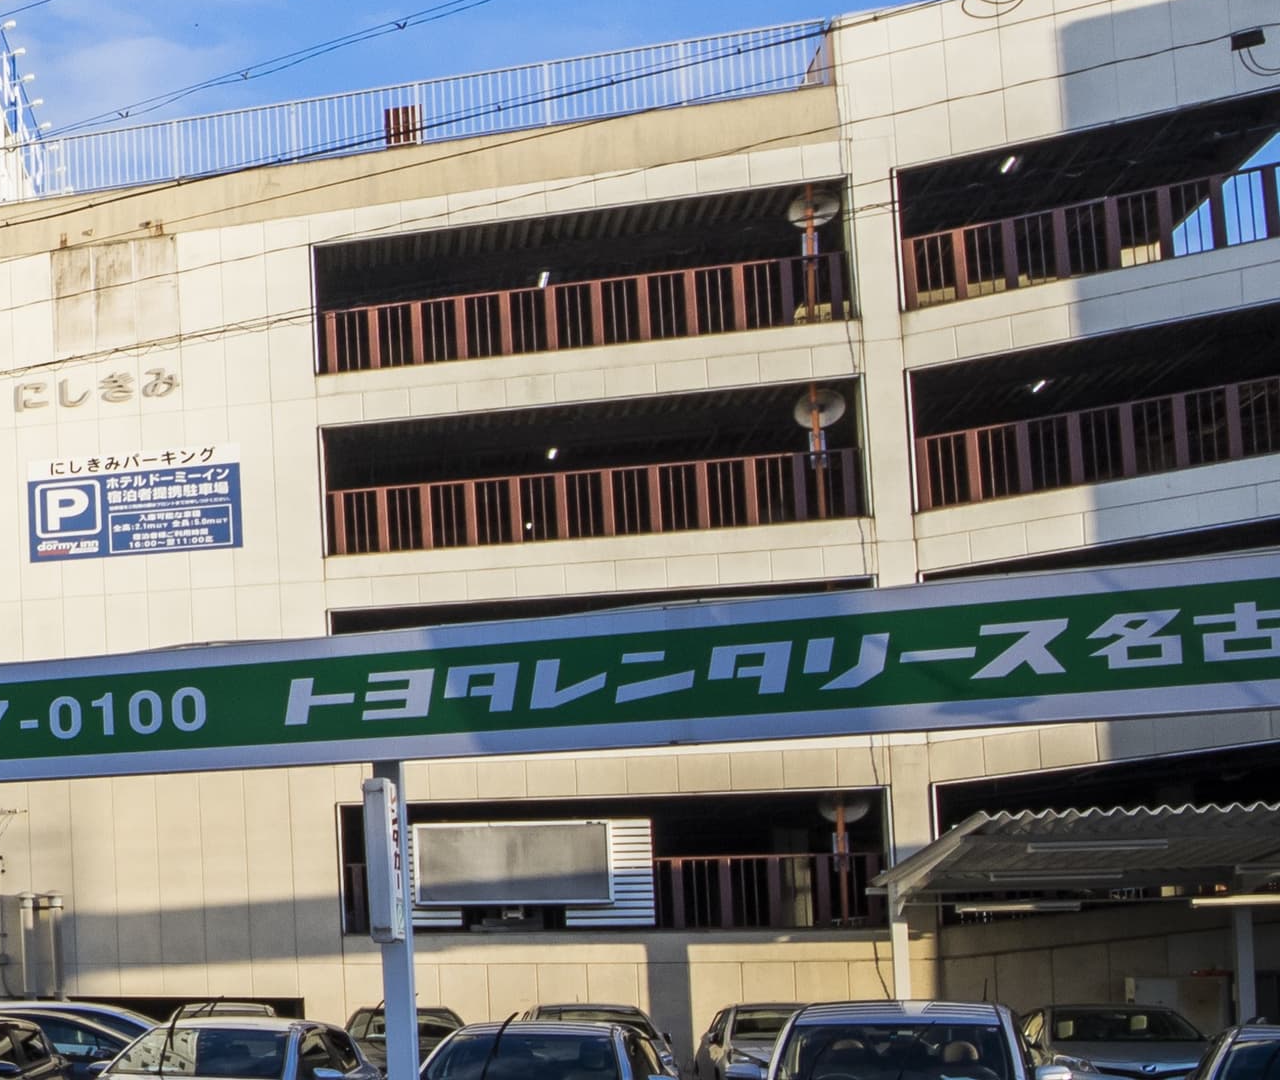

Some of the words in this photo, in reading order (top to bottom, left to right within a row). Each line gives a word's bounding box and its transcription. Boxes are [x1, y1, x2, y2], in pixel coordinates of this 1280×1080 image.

[14, 368, 179, 412] にしきみ
[50, 446, 215, 476] にしきみパーキング
[106, 468, 229, 489] ホテルドーミーイン
[46, 489, 89, 531] P
